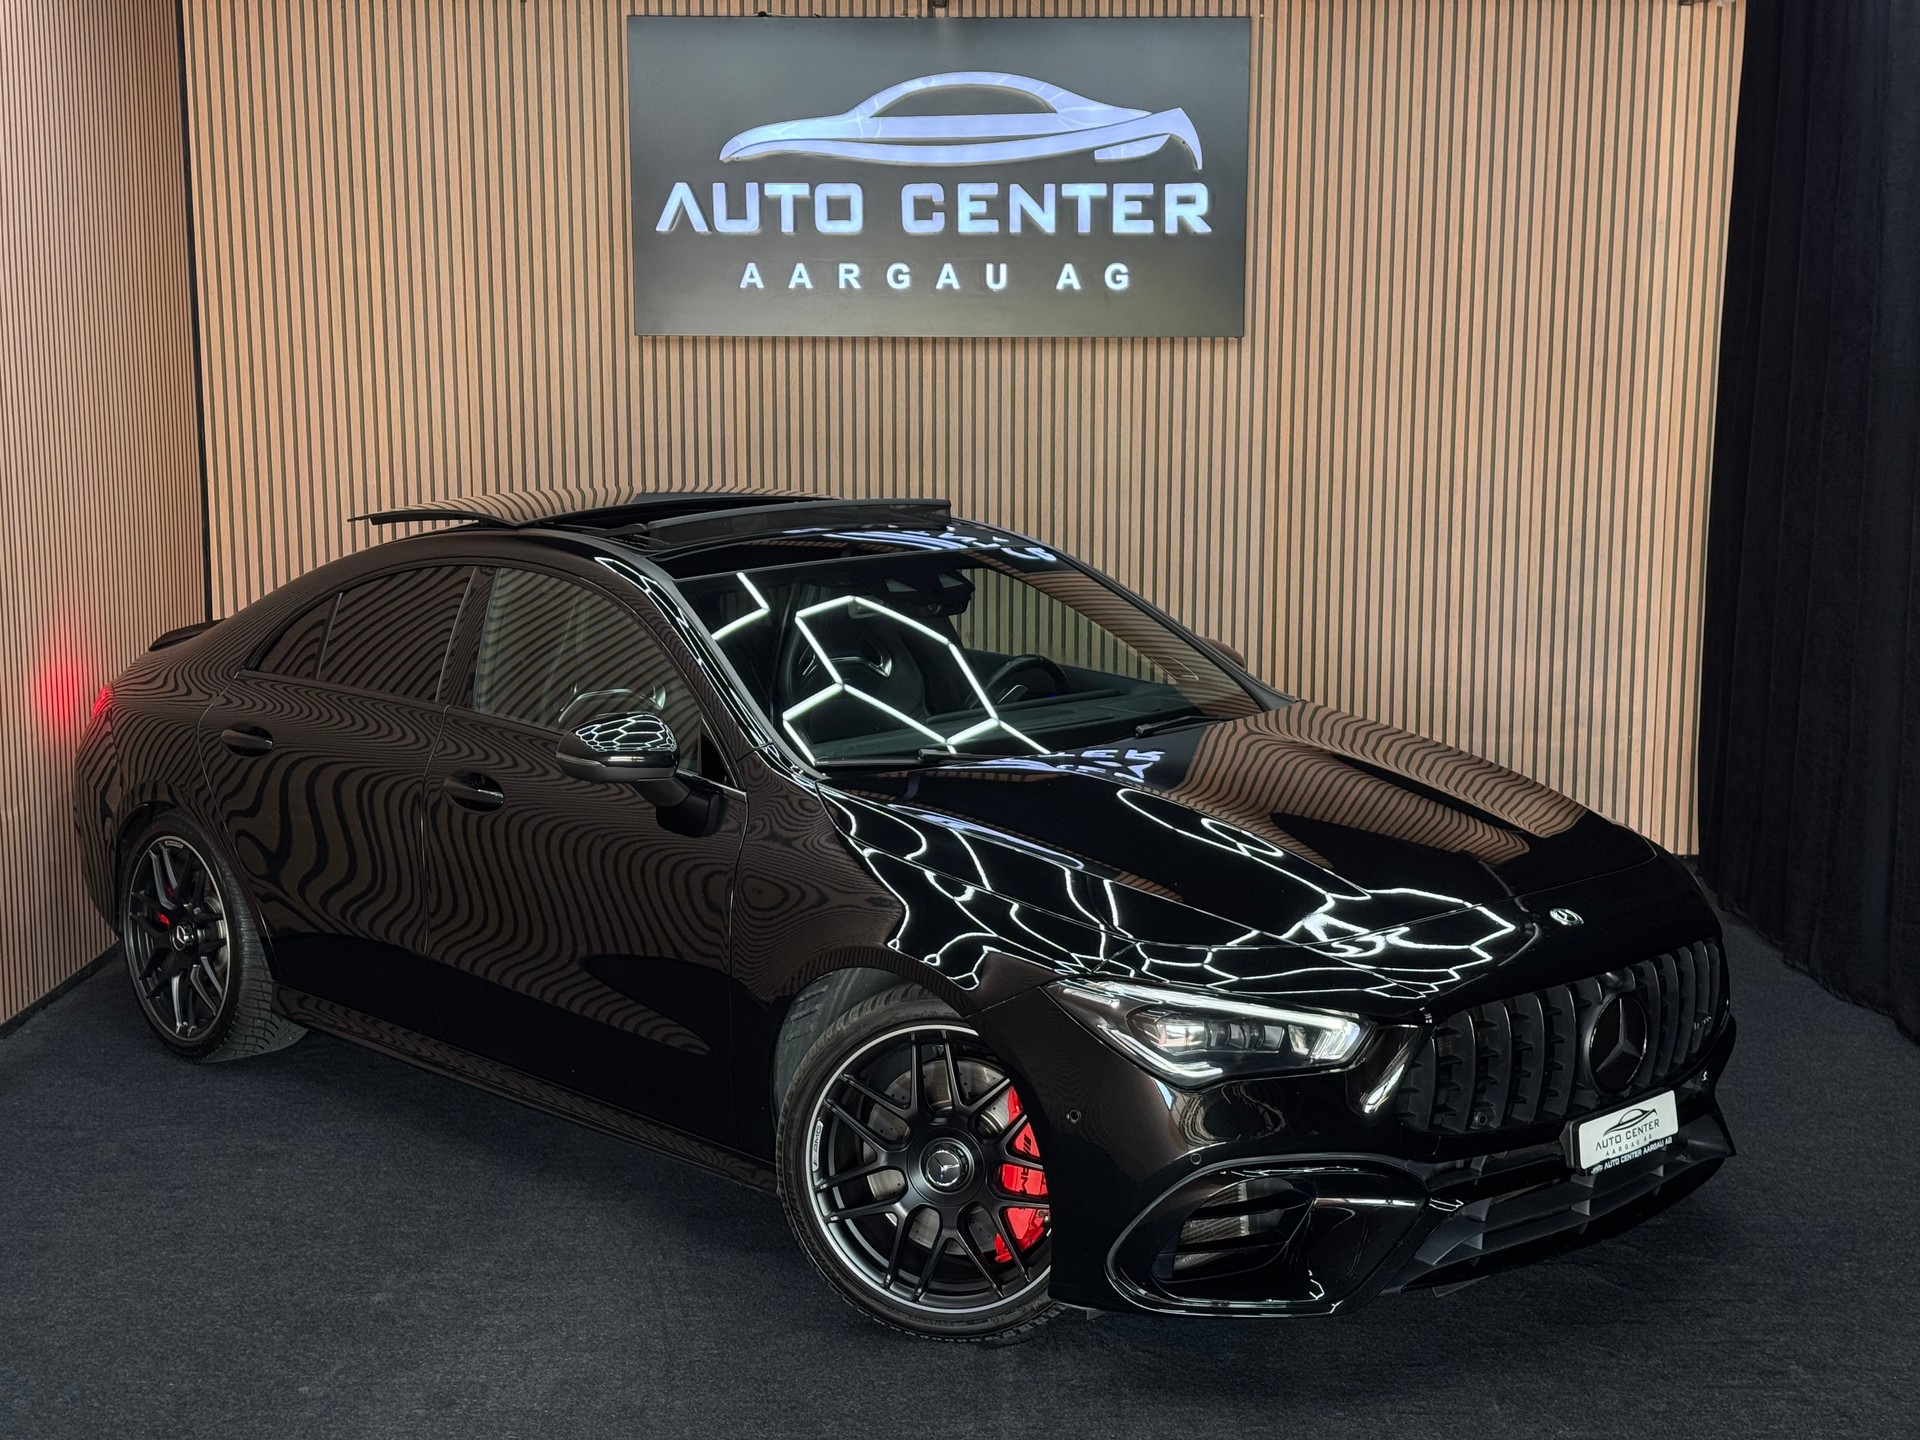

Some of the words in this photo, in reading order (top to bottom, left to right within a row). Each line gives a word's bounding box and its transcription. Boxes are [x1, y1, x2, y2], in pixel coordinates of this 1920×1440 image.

[655, 182, 862, 234] AUTO
[901, 182, 1212, 234] CENTER
[740, 262, 1008, 291] AARGAU
[1057, 262, 1130, 291] AG
[1596, 1134, 1622, 1151] AUTO
[1626, 1119, 1660, 1140] CENTER
[1606, 1140, 1639, 1157] AARGAU
[1644, 1133, 1652, 1142] AG
[1604, 1158, 1620, 1170] AUTO
[1621, 1149, 1643, 1163] CENTER
[1643, 1140, 1664, 1155] AARGAU
[1665, 1136, 1673, 1146] AG
